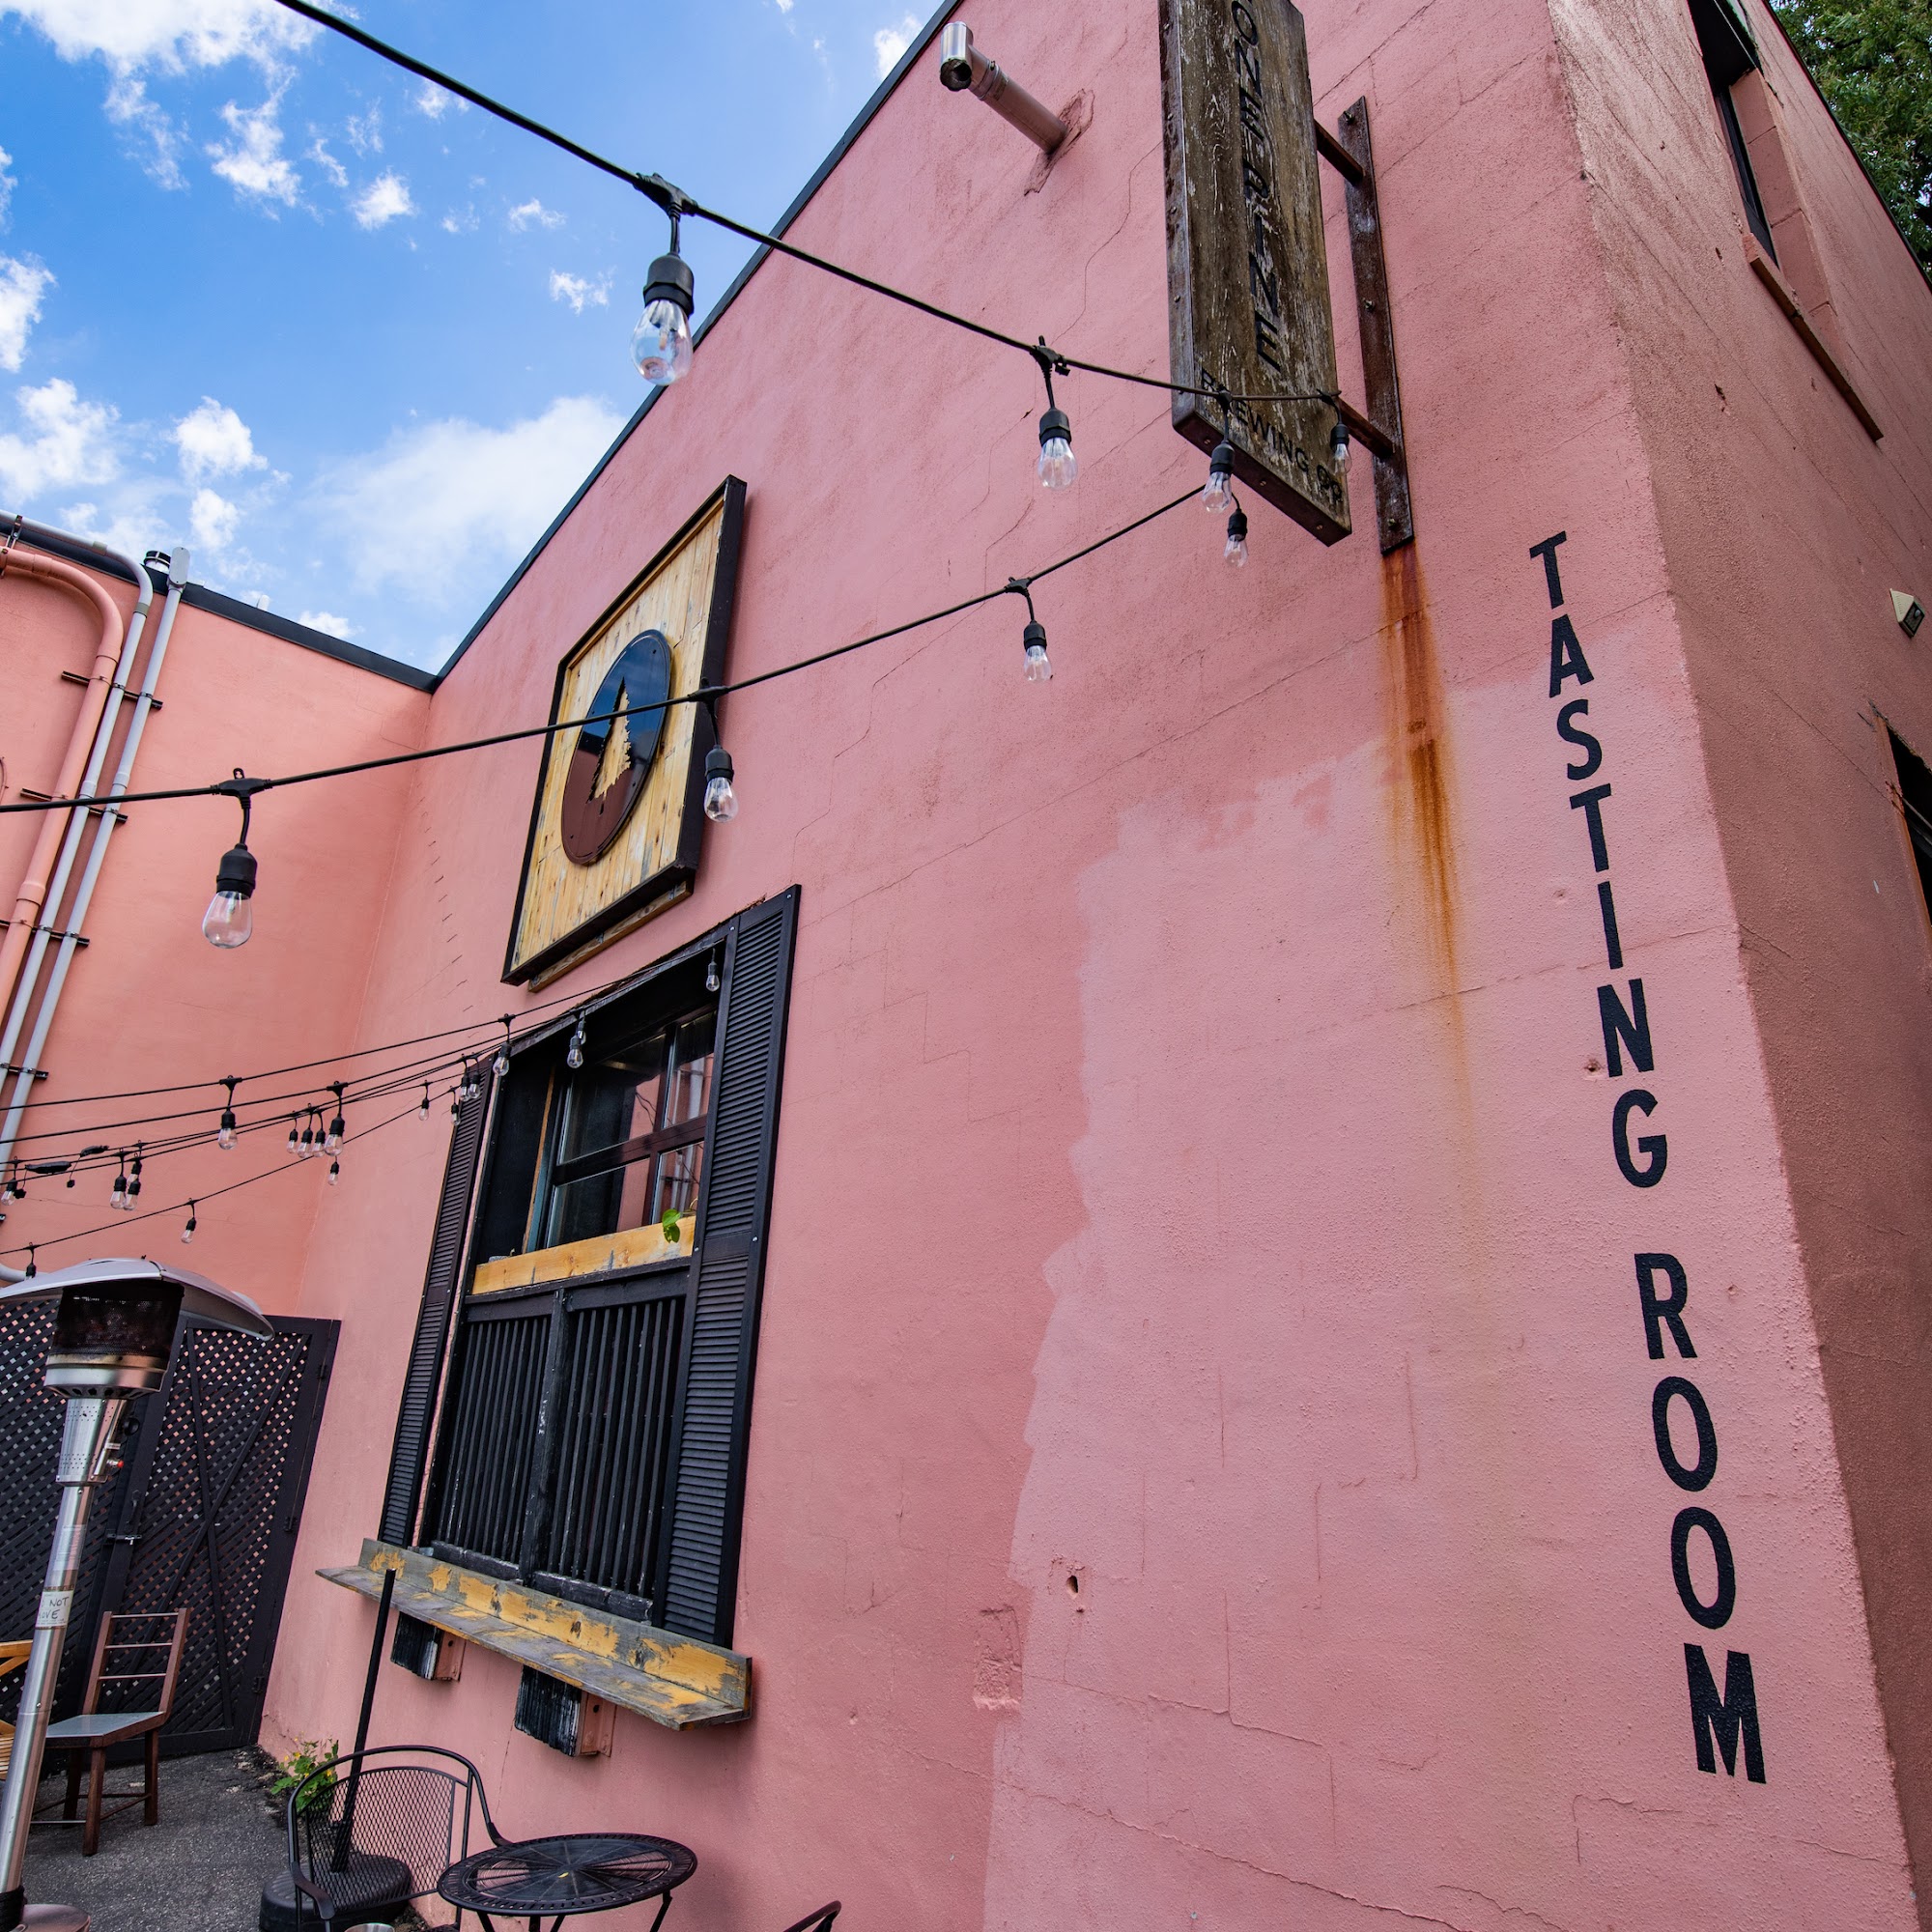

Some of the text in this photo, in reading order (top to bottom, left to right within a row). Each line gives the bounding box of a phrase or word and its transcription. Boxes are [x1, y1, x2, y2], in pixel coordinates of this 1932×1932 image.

[1232, 0, 1282, 373] ONE PINE
[1201, 367, 1310, 474] BEWING
[1529, 530, 1767, 1785] TASTING ROOM
[39, 1608, 61, 1620] OVE
[49, 1596, 70, 1607] NOT
